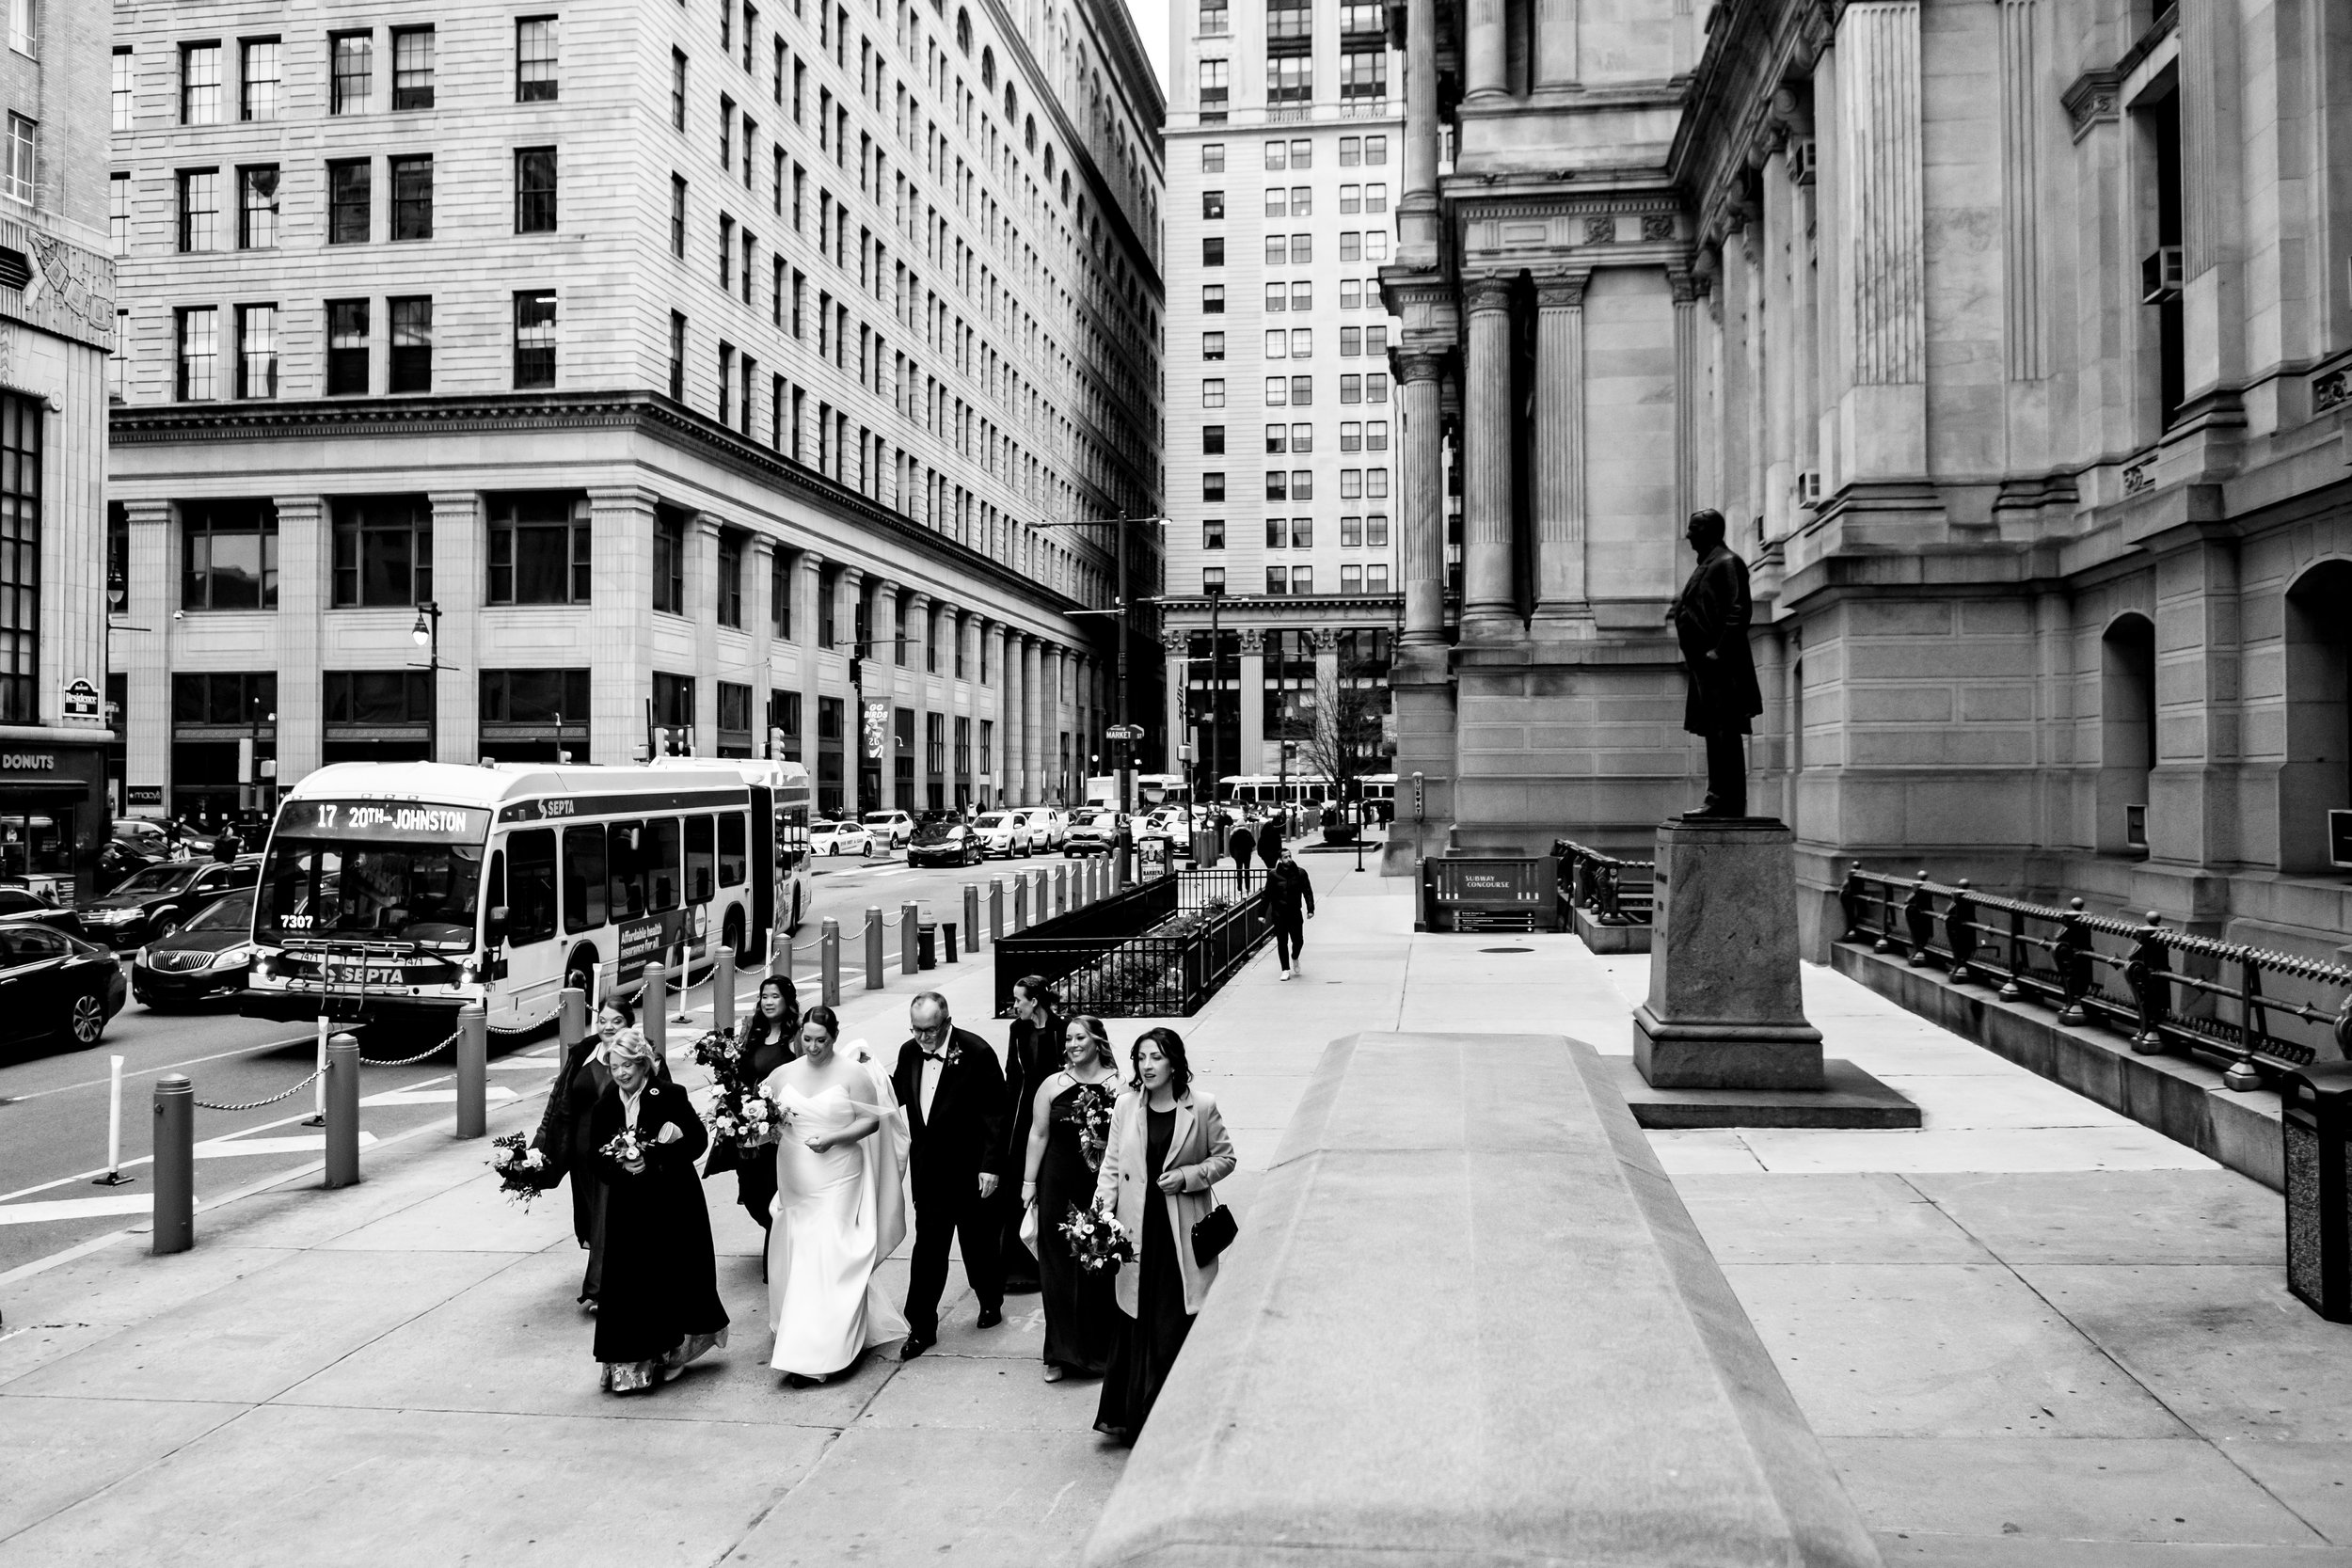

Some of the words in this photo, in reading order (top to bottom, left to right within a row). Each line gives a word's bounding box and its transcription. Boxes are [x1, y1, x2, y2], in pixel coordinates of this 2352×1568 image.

[1271, 610, 1396, 618] WIDENE
[66, 692, 97, 705] Residence
[864, 710, 888, 719] BIRDS
[1106, 731, 1131, 739] MARKET
[3, 754, 54, 769] DONUTS
[134, 791, 161, 800] macy's
[548, 800, 574, 816] SEPTA
[317, 804, 338, 828] 17
[280, 915, 313, 928] 7307
[621, 927, 647, 944] Affordable
[646, 923, 662, 938] health
[621, 942, 645, 959] insurance
[644, 939, 653, 951] for
[342, 967, 404, 984] SEPTA
